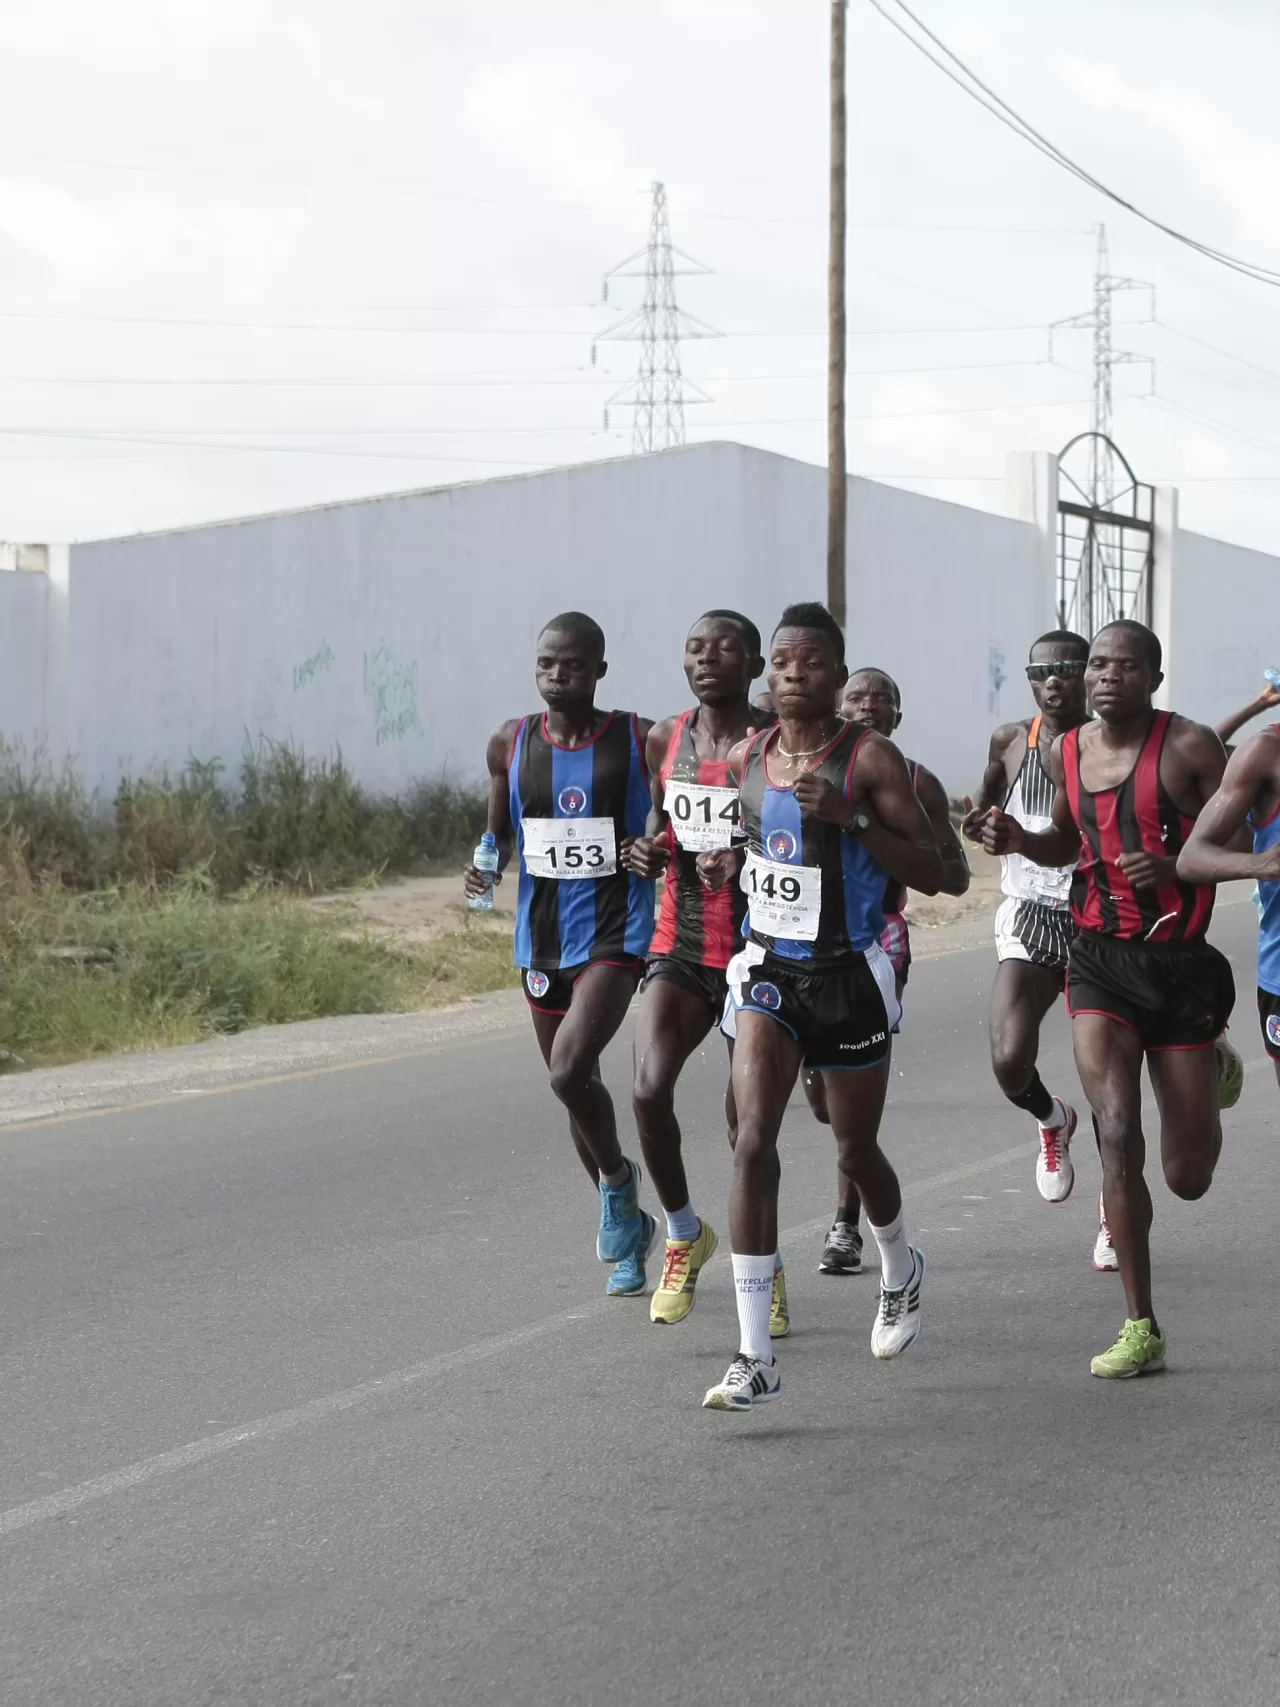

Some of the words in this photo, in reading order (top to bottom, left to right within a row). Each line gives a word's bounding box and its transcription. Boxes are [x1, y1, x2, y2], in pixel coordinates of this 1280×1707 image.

[674, 794, 741, 826] 014
[545, 844, 605, 868] 153
[749, 868, 801, 902] 149
[870, 1031, 886, 1044] XXI
